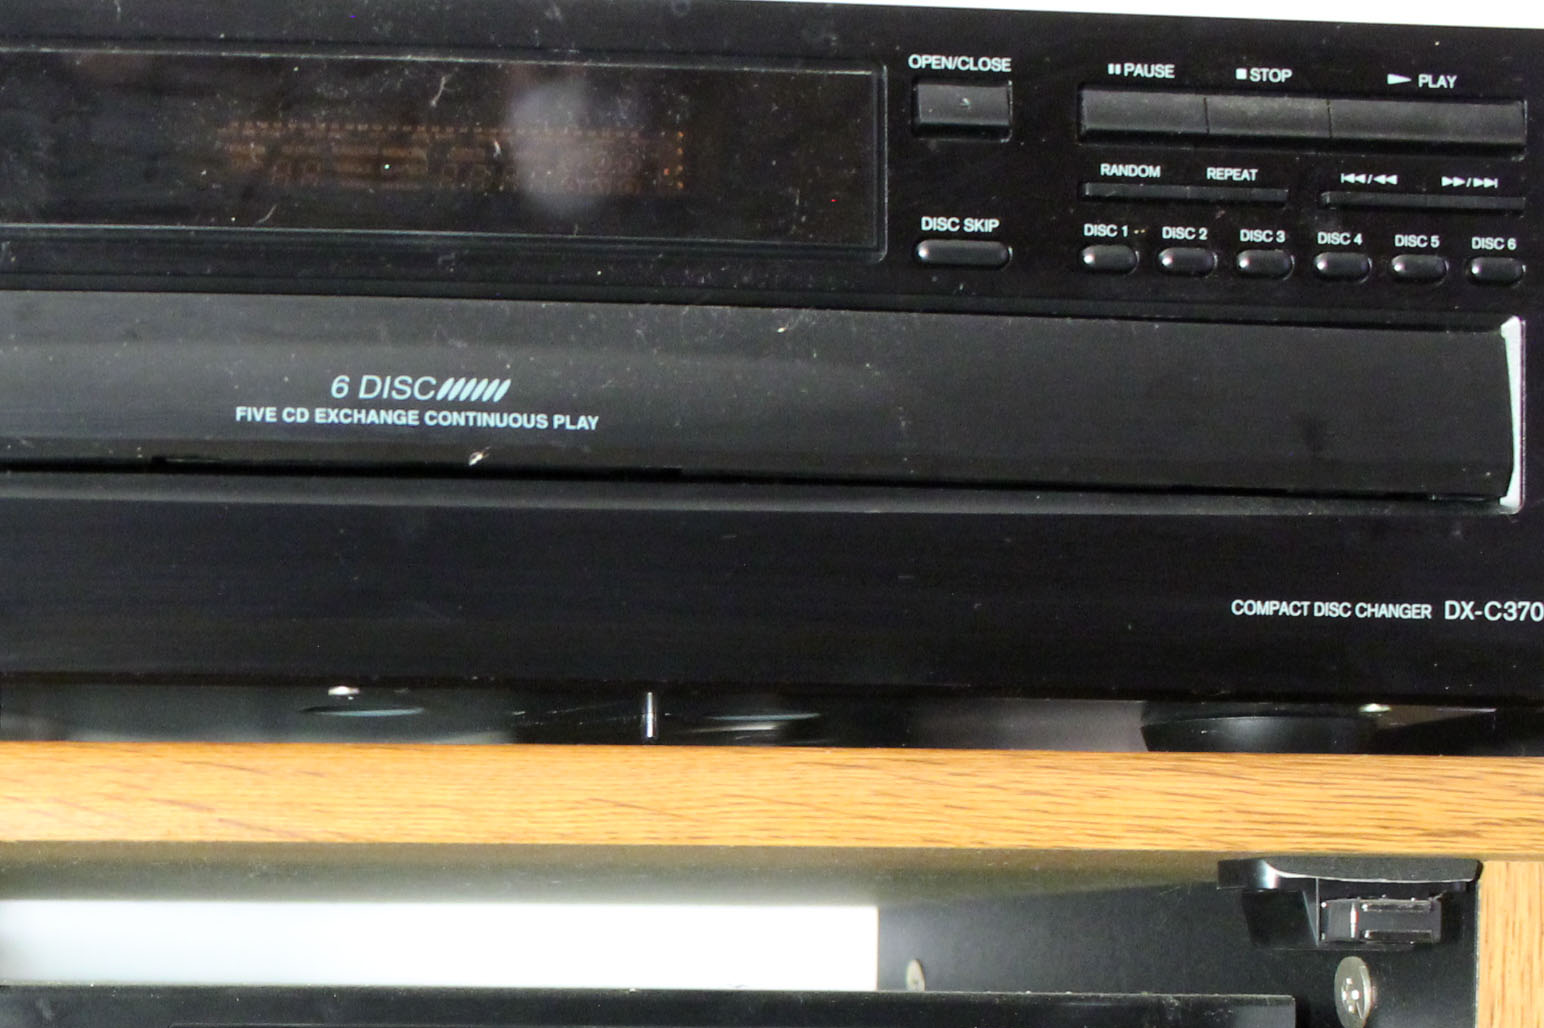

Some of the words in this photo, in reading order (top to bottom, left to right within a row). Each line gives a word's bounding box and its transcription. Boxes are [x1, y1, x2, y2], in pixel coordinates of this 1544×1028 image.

[908, 54, 1011, 72] OPEN/CLOSE
[1124, 63, 1175, 79] PAUSE
[1250, 67, 1292, 83] STOP
[1419, 73, 1457, 90] PLAY
[1100, 164, 1161, 178] RANDOM
[1207, 167, 1258, 182] REPEAT
[921, 216, 960, 232] DISC
[963, 218, 1000, 233] SKIP
[1084, 224, 1118, 237] DISC
[1122, 225, 1129, 237] 1
[1162, 226, 1196, 240] DISC
[1200, 227, 1208, 240] 2
[1240, 229, 1273, 242] DISC
[1277, 230, 1285, 242] 3
[1317, 231, 1351, 246] DISC
[1355, 232, 1363, 246] 4
[1395, 234, 1427, 249] DISC
[1432, 235, 1440, 249] 5
[1472, 237, 1504, 251] DISC
[1508, 238, 1517, 251] 6
[331, 375, 349, 398] 6
[359, 375, 437, 400] DISC
[236, 406, 277, 422] FIVE
[282, 407, 309, 423] CD
[314, 408, 419, 425] EXCHANGE
[424, 410, 548, 428] CONTINUOUS
[554, 413, 599, 431] PLAY
[1231, 599, 1309, 617] COMPACT
[1313, 602, 1351, 618] DISC
[1355, 602, 1432, 620] CHANGER
[1444, 600, 1544, 622] DX-C370
